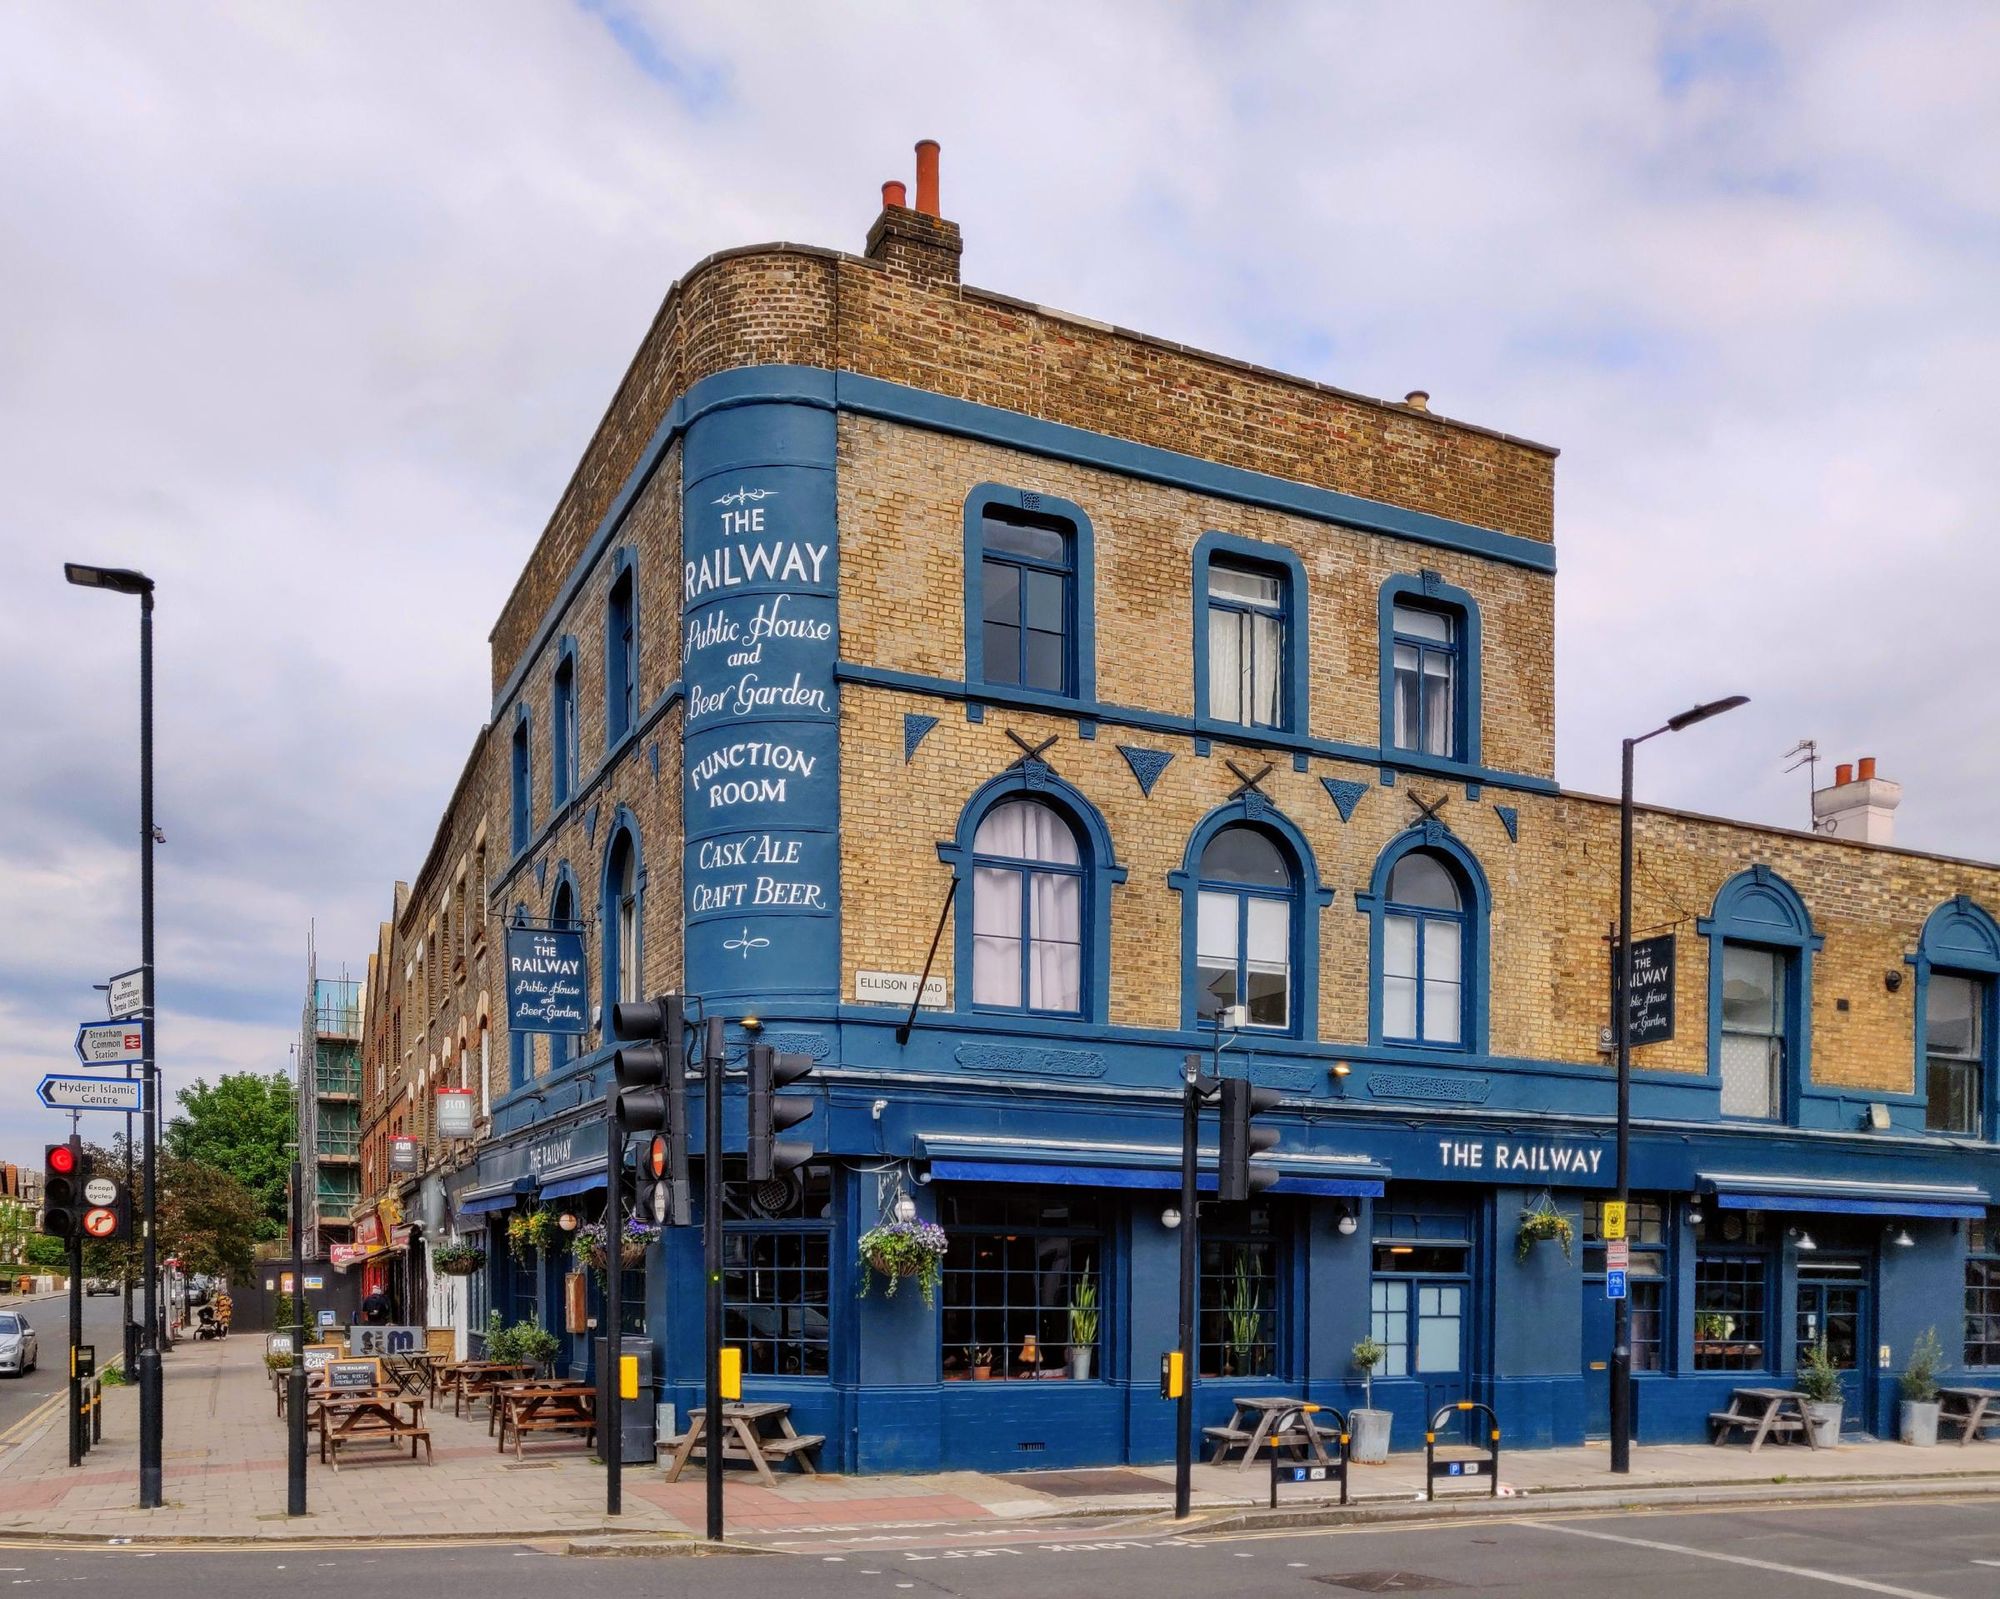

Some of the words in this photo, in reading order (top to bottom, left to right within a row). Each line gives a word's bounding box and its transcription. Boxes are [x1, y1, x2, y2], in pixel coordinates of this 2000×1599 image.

[721, 508, 764, 536] THE
[685, 541, 829, 602] RAILWAY
[684, 609, 741, 664] Public
[742, 594, 831, 646] House
[727, 643, 762, 667] and
[685, 685, 735, 727] Beer
[733, 673, 830, 715] Garden
[691, 742, 817, 792] FUNCTION
[709, 778, 786, 808] ROOM
[534, 946, 557, 957] THE
[512, 957, 579, 975] RAILWAY
[1634, 957, 1651, 969] THE
[515, 980, 547, 996] Public
[549, 980, 580, 996] House
[860, 977, 907, 991] ELLISON
[541, 995, 555, 1004] and
[516, 1003, 546, 1017] Beer
[543, 1005, 581, 1022] Garden
[89, 1030, 122, 1039] Streatham
[92, 1040, 121, 1049] Common
[95, 1050, 118, 1059] Station
[59, 1082, 95, 1094] Hyderi
[100, 1084, 135, 1095] Islamic
[81, 1094, 118, 1104] Centre
[1439, 1142, 1483, 1168] THE
[1495, 1145, 1602, 1173] RAILWAY
[904, 1548, 1022, 1560] LEFT
[1039, 1541, 1152, 1552] LOOK
